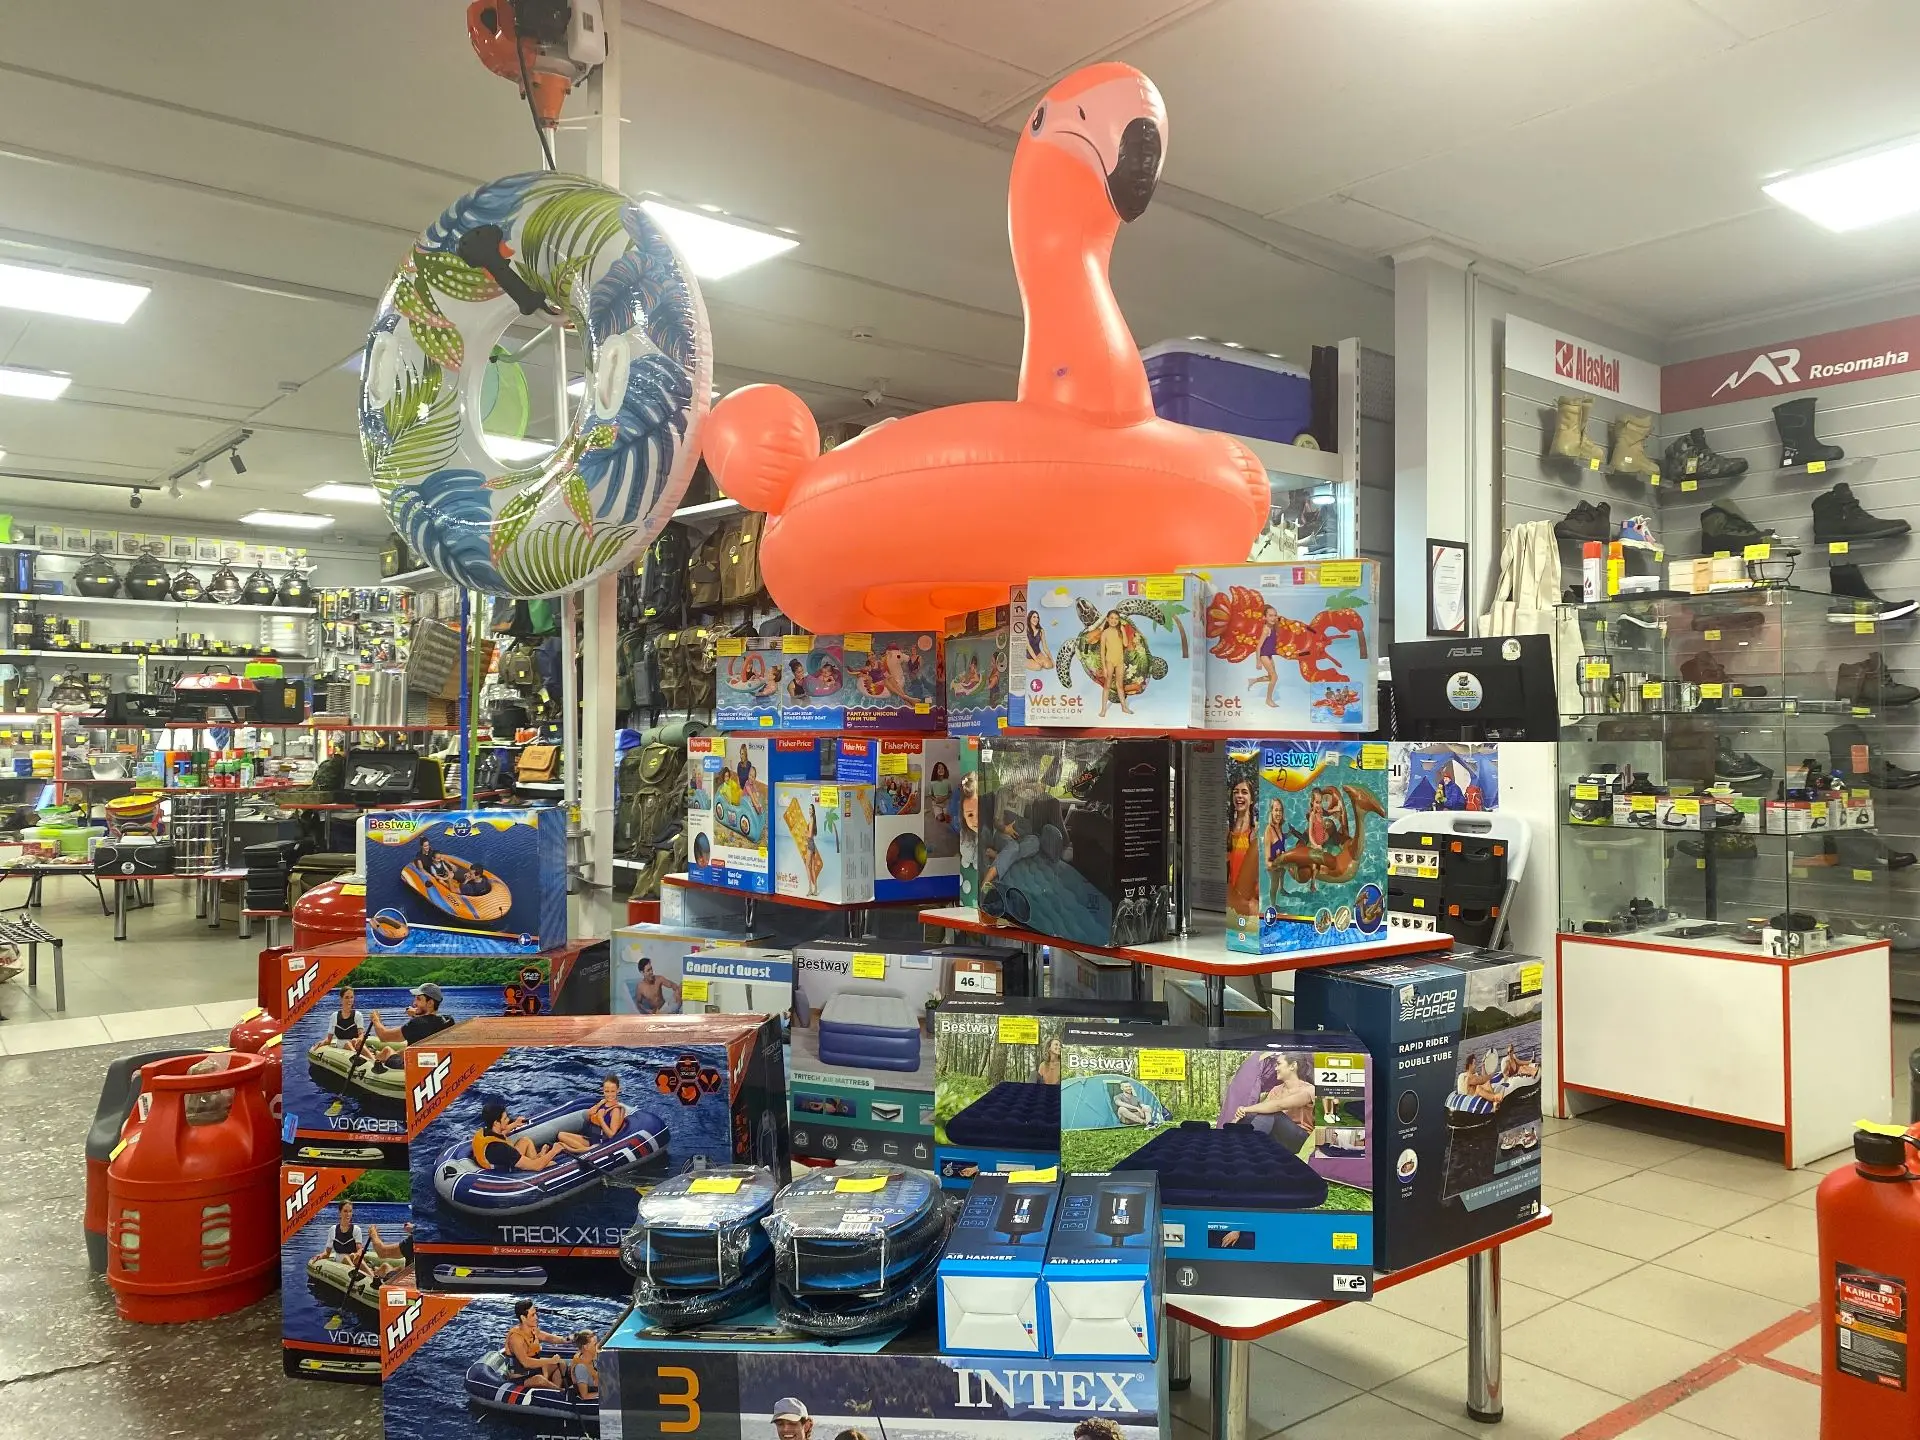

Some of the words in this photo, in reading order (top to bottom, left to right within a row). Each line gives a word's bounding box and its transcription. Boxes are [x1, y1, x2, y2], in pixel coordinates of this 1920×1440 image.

[1809, 350, 1910, 381] Rosomaha
[1447, 646, 1484, 658] ASUS
[1028, 695, 1056, 708] Wet
[1059, 695, 1083, 708] Set
[1214, 694, 1242, 709] Set
[1030, 707, 1083, 715] COLLECTION
[1265, 750, 1318, 770] Bestway
[369, 818, 418, 832] Bestway
[686, 960, 735, 976] Comfort
[736, 963, 771, 978] Quest
[797, 957, 849, 974] Bestway
[286, 960, 319, 1010] HF
[960, 977, 975, 987] 46
[1416, 988, 1458, 1004] HYDRO
[1413, 1001, 1456, 1019] FORCE
[941, 1020, 998, 1037] Bestway
[1399, 1042, 1424, 1054] RAPID
[1425, 1035, 1450, 1048] RIDER
[1068, 1053, 1134, 1074] Bestway
[1398, 1054, 1431, 1070] DOUBLE
[1431, 1050, 1453, 1063] TUBE
[412, 1052, 452, 1114] HF
[793, 1072, 821, 1081] TRITECH
[835, 1077, 870, 1087] MATTRESS
[1321, 1071, 1338, 1083] 22
[410, 1063, 477, 1132] HYDRO-FORCE
[328, 1116, 398, 1133] VOYAGER
[285, 1172, 318, 1221] HF
[498, 1225, 571, 1244] TRECK
[575, 1226, 600, 1245] X1
[1349, 1276, 1365, 1289] GS
[1845, 1285, 1895, 1306] КАНИСТРА
[386, 1294, 423, 1353] HF
[328, 1330, 380, 1347] VOYAG
[657, 1366, 701, 1433] 3
[952, 1367, 1139, 1414] INTEX
